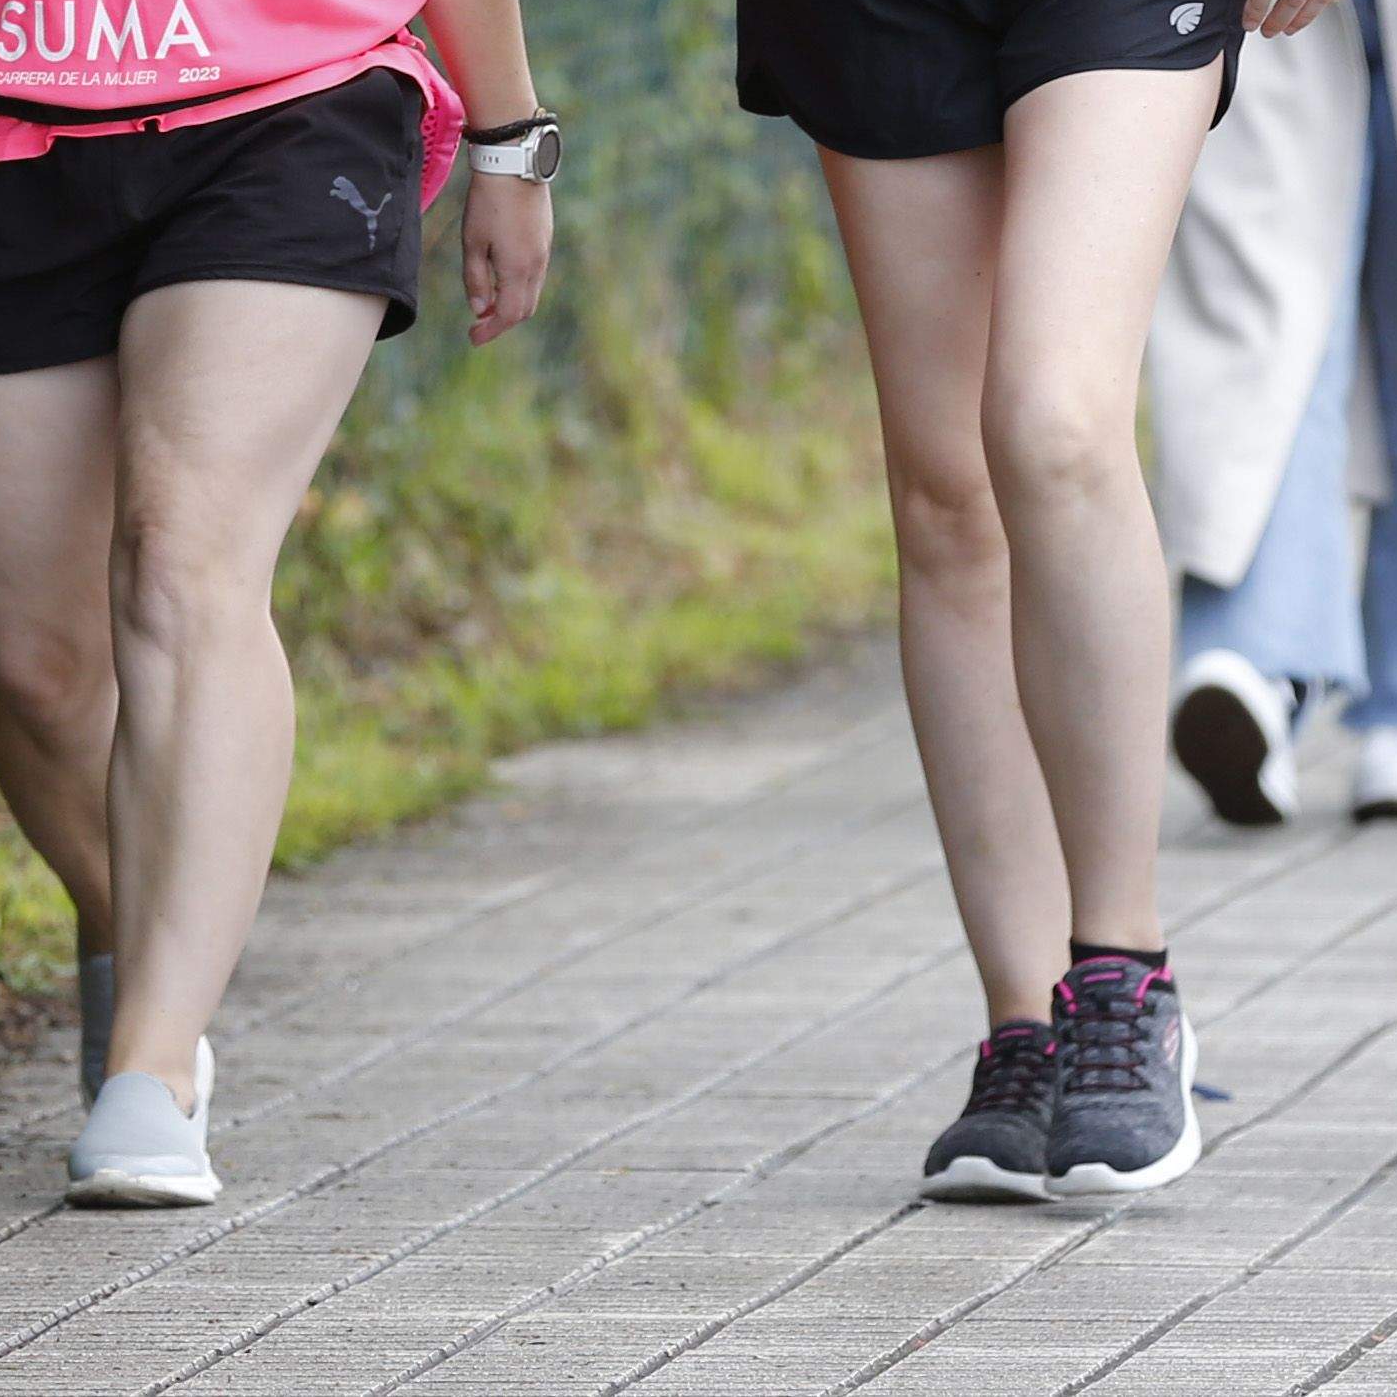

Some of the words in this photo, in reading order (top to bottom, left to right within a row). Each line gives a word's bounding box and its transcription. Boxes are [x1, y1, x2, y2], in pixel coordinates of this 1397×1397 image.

[59, 71, 80, 85] DE
[82, 71, 100, 85] LA
[105, 71, 158, 85] MUJER
[179, 67, 221, 83] 2023
